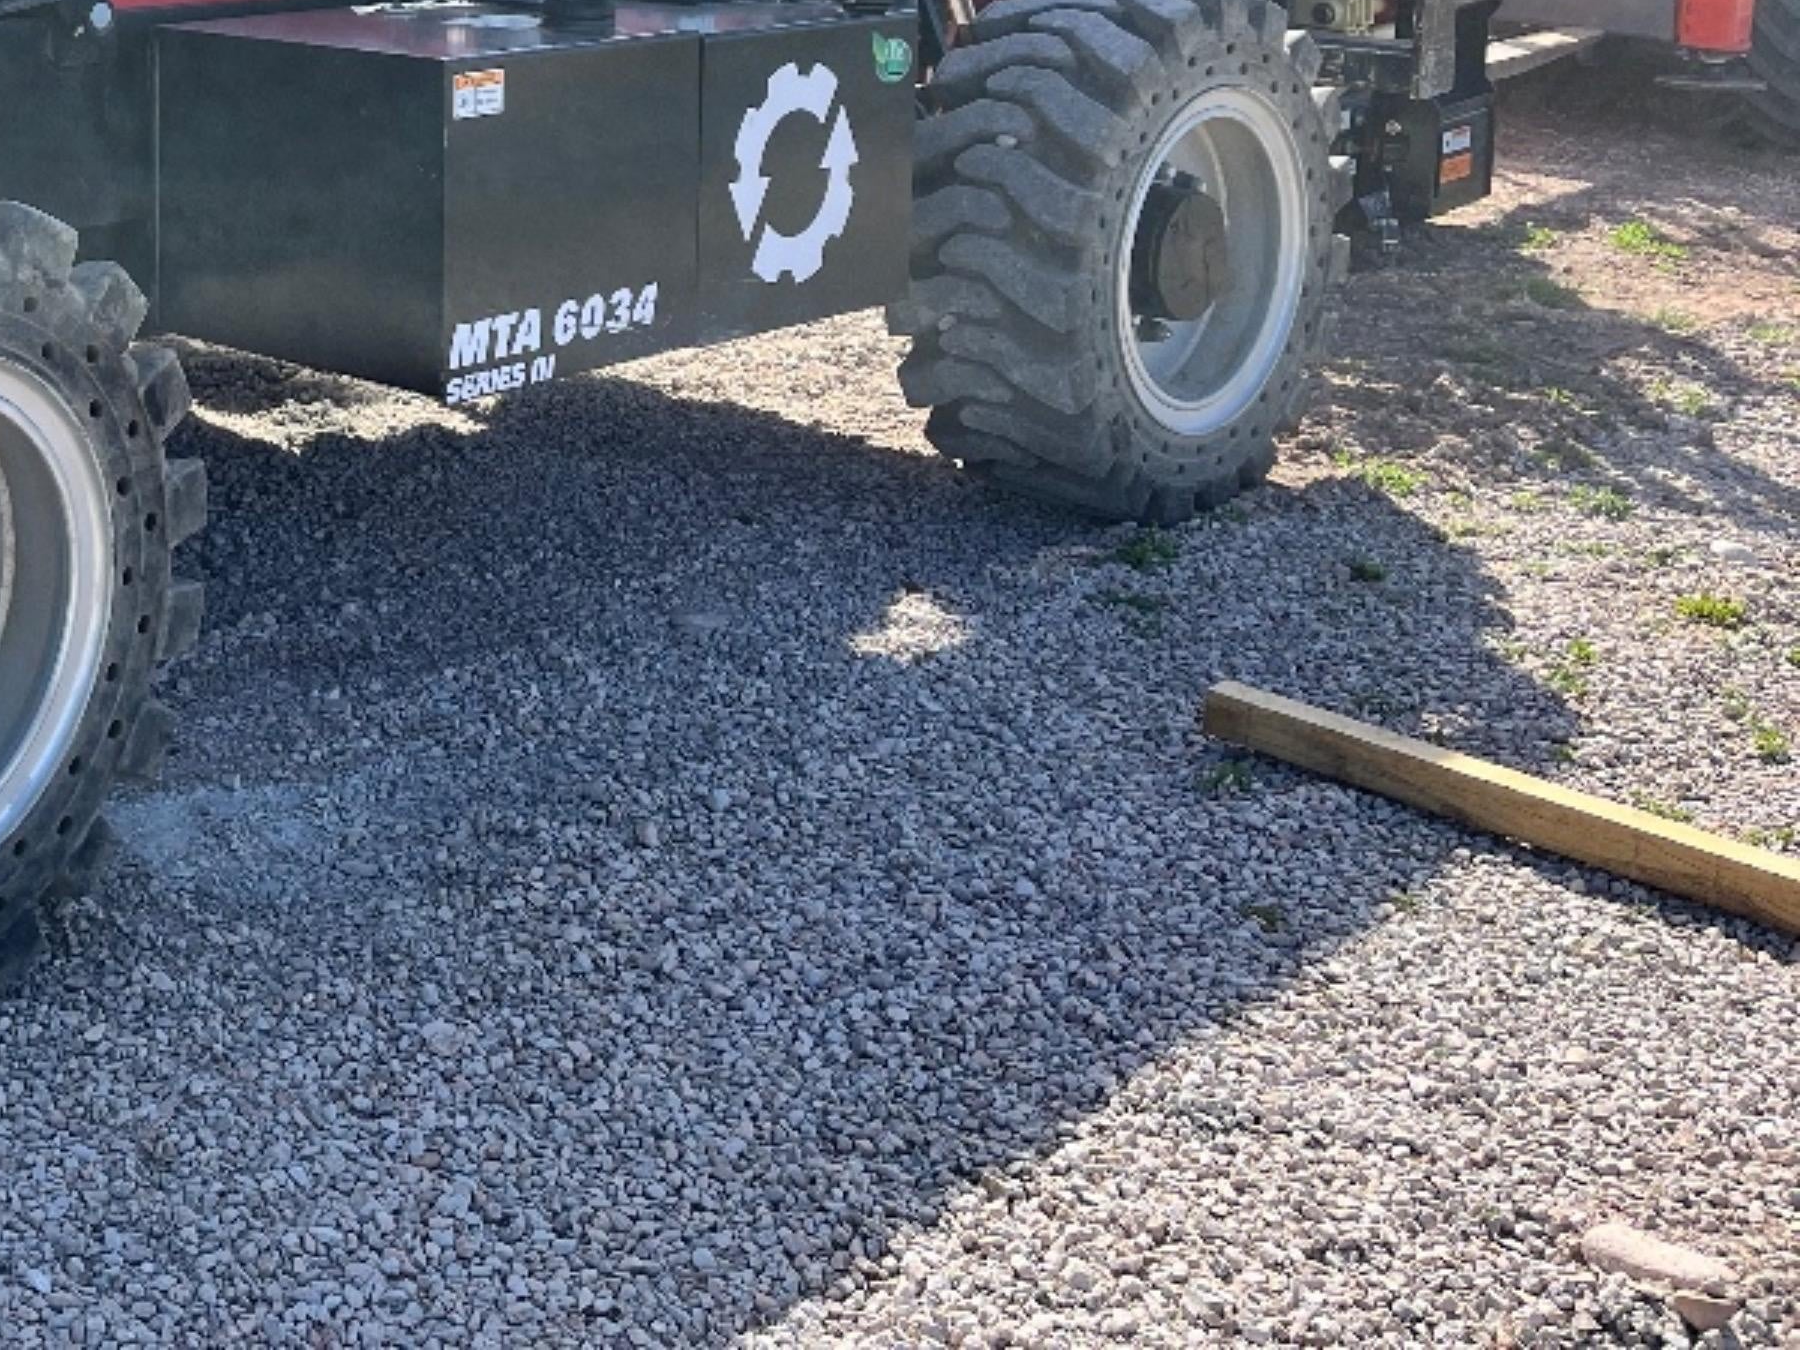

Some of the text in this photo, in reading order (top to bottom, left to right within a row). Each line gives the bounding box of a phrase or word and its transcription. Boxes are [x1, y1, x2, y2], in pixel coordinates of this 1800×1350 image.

[449, 281, 659, 370] MTA 6034
[446, 361, 526, 405] SERIES
